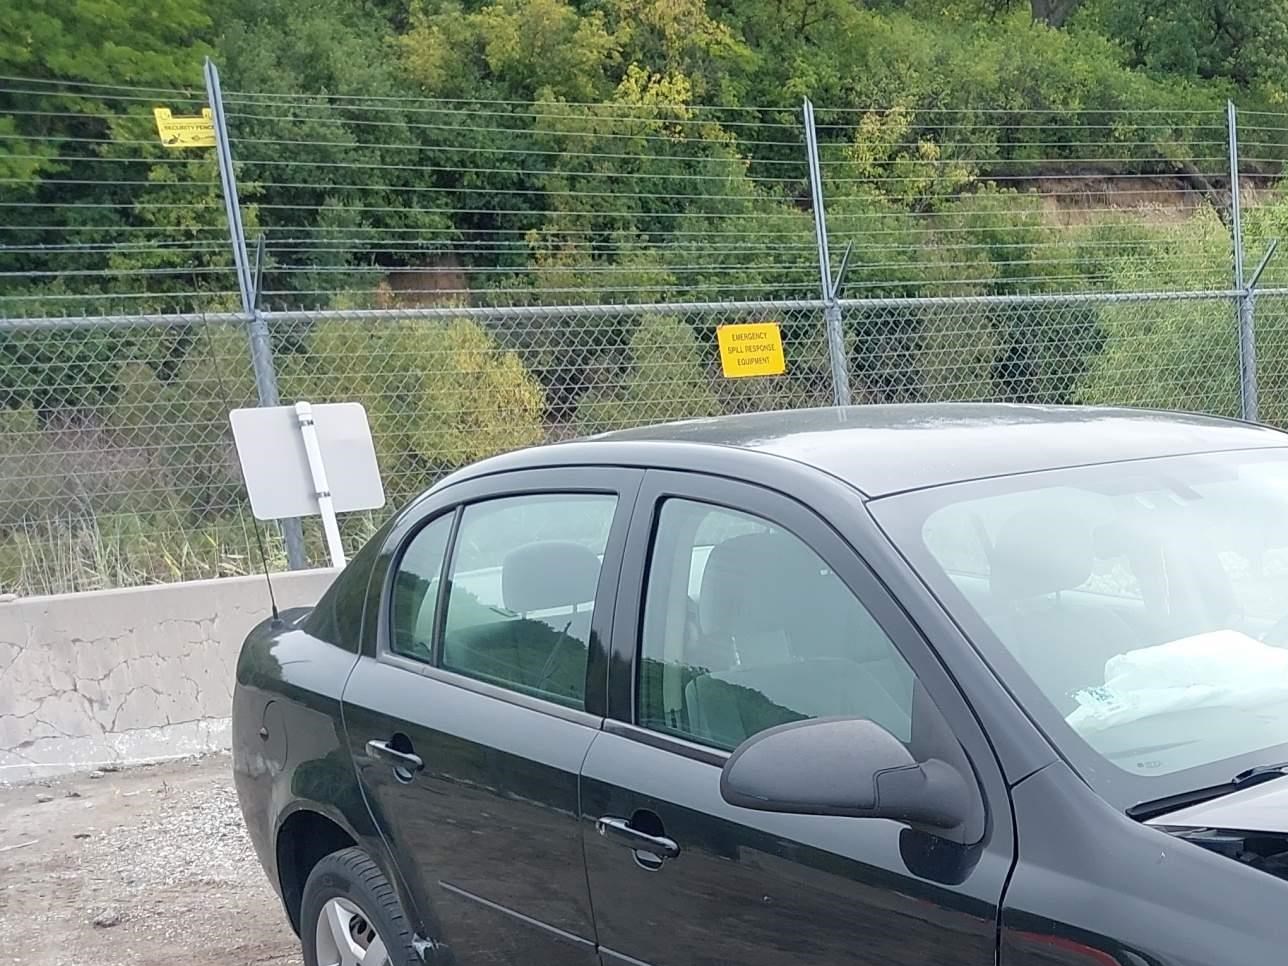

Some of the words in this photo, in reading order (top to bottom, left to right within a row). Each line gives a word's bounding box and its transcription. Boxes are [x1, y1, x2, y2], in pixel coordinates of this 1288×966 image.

[731, 332, 767, 342] EMERGENCY
[727, 345, 744, 354] SPILL
[744, 343, 776, 353] RESPONSE
[737, 356, 770, 366] EQUIPMENT
